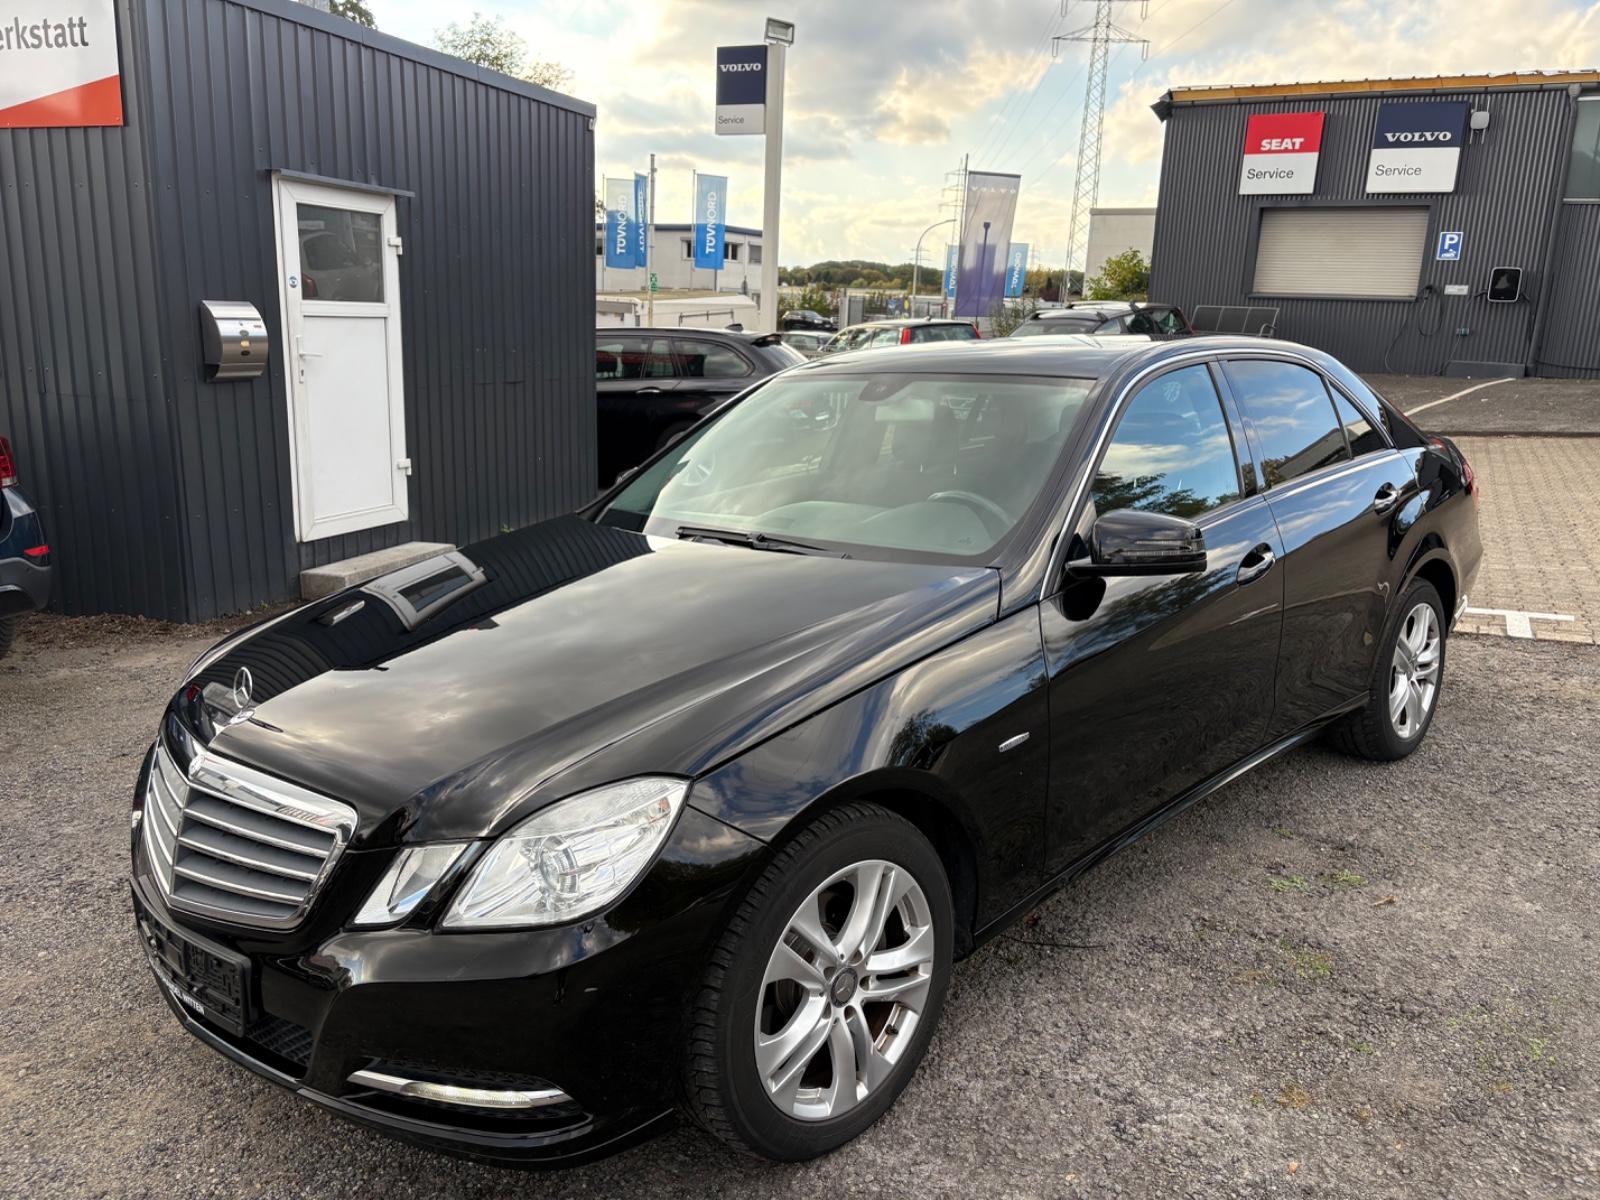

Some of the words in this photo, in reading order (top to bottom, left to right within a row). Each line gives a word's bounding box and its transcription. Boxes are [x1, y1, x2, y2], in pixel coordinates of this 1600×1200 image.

[719, 63, 762, 73] VOLVO
[717, 115, 745, 125] Service
[1384, 131, 1452, 143] VOLVO
[1260, 138, 1304, 151] SEAT
[1246, 167, 1294, 180] Service
[1375, 164, 1422, 177] Service
[1443, 233, 1459, 250] P
